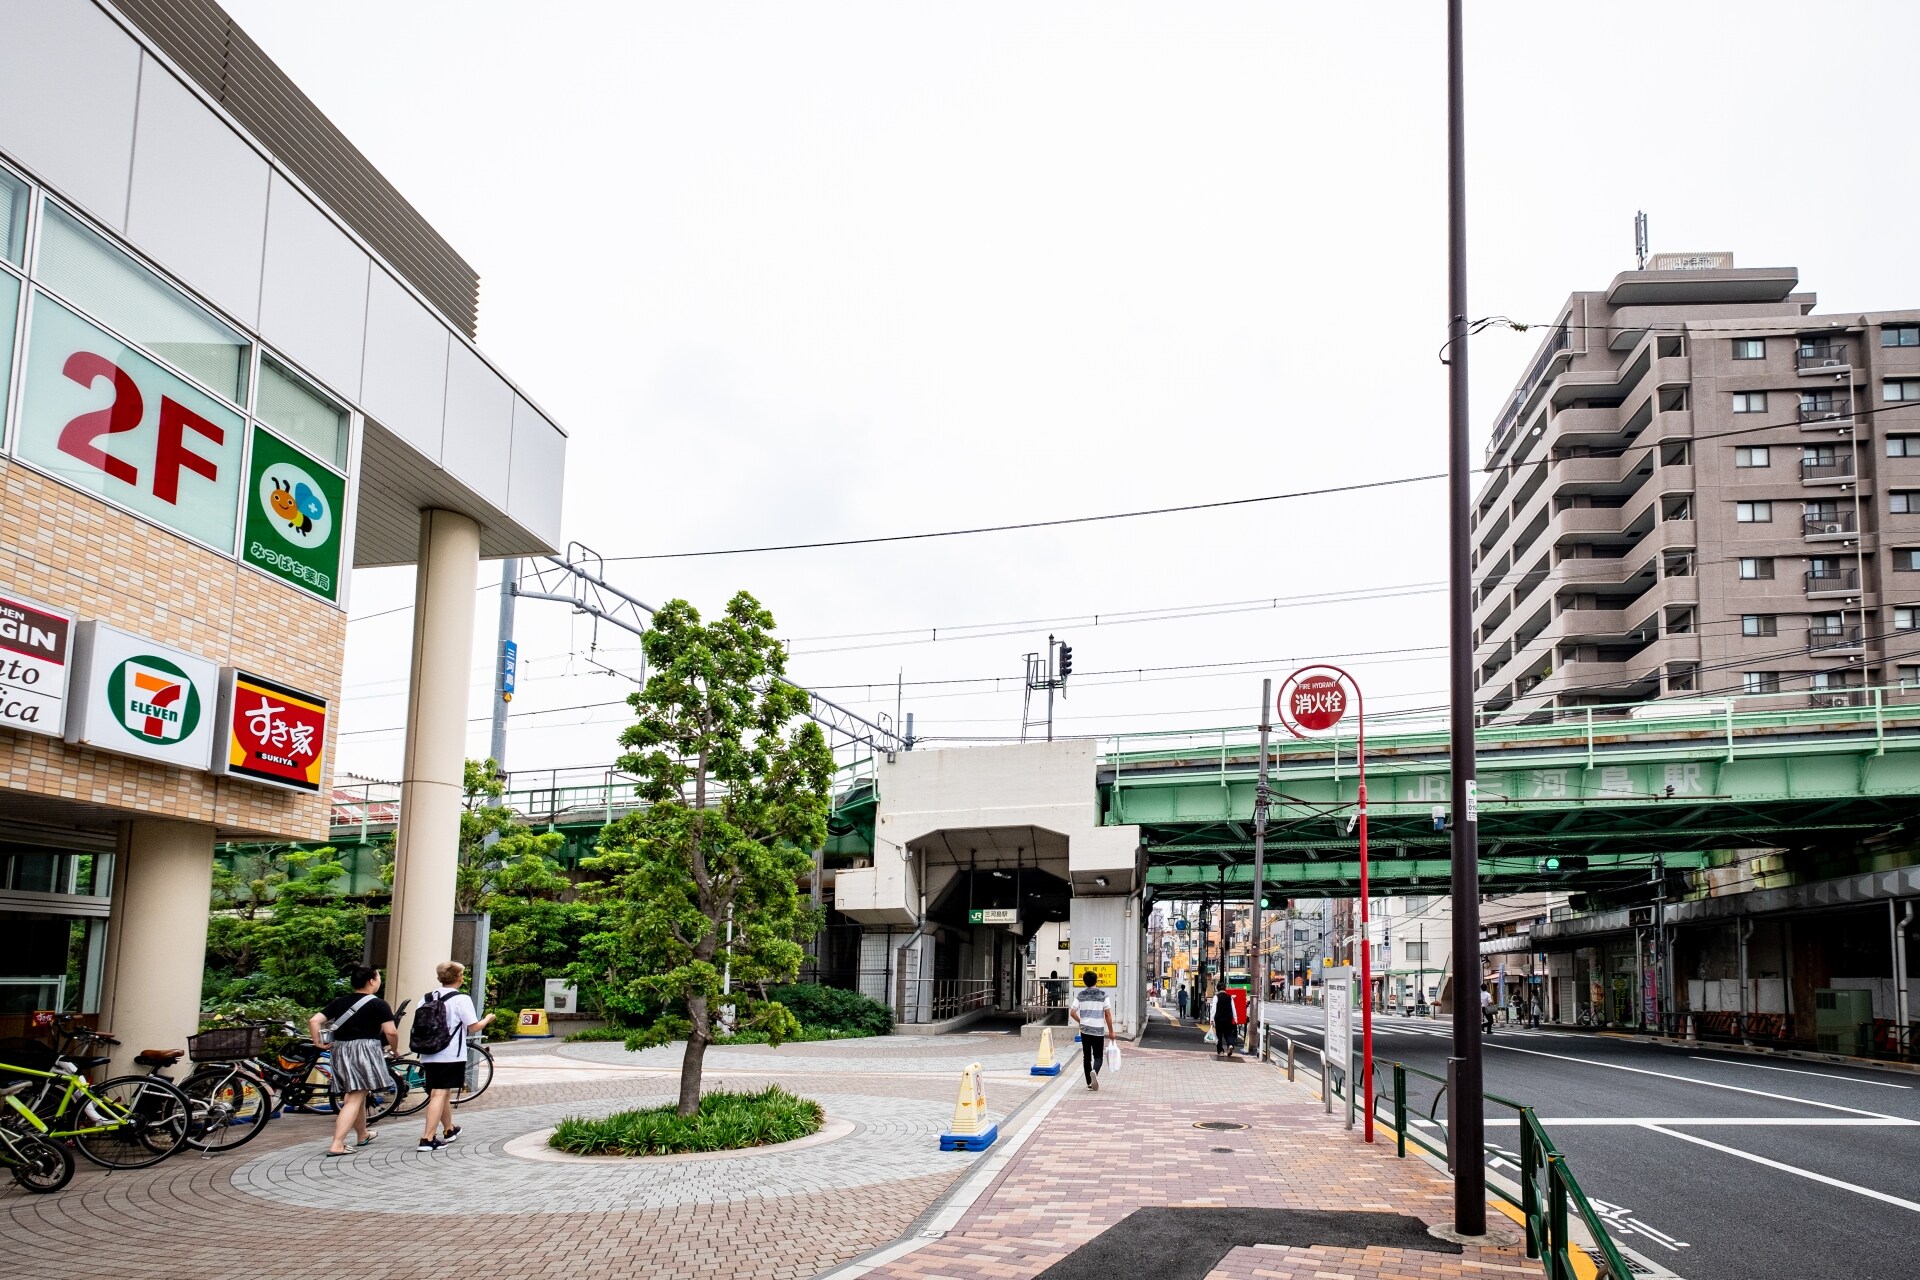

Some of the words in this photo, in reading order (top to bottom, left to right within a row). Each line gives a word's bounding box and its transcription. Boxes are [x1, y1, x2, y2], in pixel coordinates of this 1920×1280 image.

[57, 351, 224, 505] 2F
[1312, 681, 1336, 689] HYDRANT
[1295, 690, 1342, 715] 消火栓
[245, 696, 315, 758] すき家
[261, 752, 293, 767] SUKIYA
